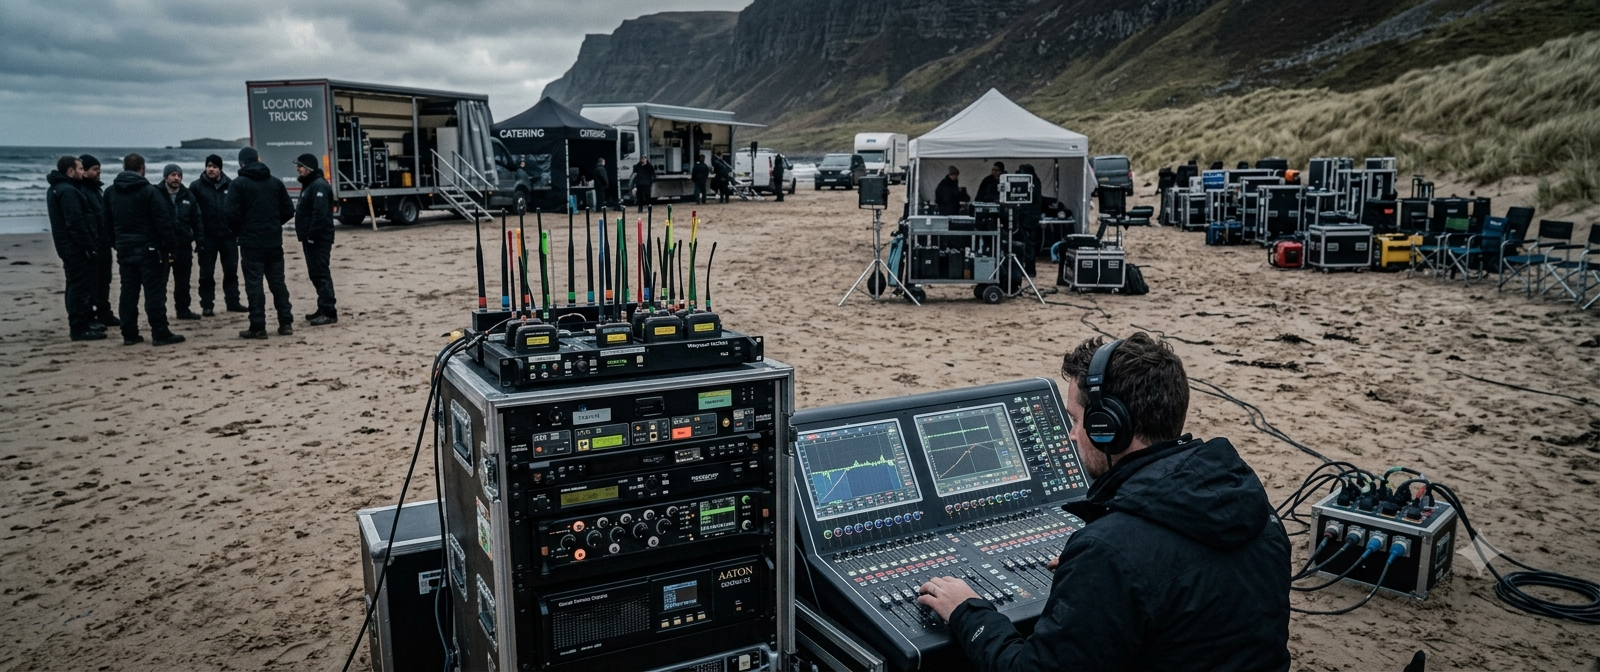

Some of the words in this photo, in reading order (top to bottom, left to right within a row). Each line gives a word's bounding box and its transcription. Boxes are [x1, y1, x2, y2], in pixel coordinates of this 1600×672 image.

[262, 98, 313, 110] LOCATION
[268, 111, 309, 122] TRUCKS
[499, 128, 545, 138] CATERING
[718, 565, 753, 581] AATON
